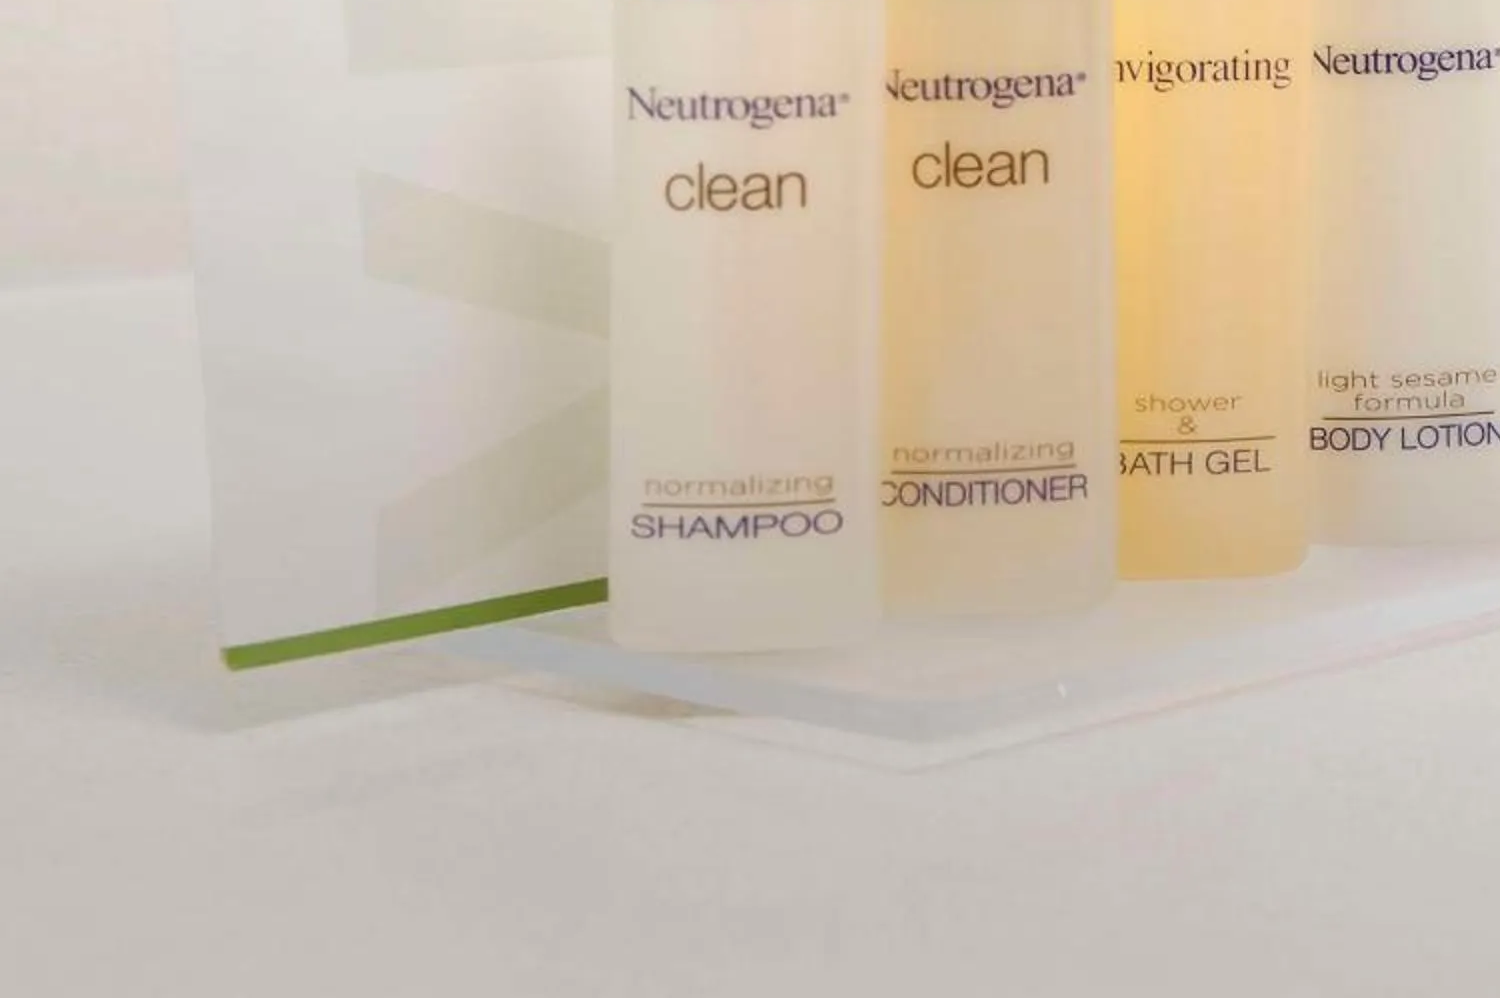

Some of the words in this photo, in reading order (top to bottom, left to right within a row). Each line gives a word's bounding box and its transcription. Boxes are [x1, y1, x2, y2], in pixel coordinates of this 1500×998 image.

[1114, 49, 1291, 93] nvigorating
[912, 140, 1049, 189] clean
[664, 160, 807, 212] clean
[1318, 369, 1380, 392] light
[1391, 368, 1498, 390] sesame
[1135, 394, 1243, 413] shower
[1354, 390, 1466, 411] formula
[1177, 415, 1198, 435] &
[1309, 426, 1391, 451] BODY
[892, 440, 1075, 464] normalizing
[1205, 449, 1272, 475] GEL
[645, 474, 834, 497] normalizing
[630, 509, 844, 540] SHAMPOO
